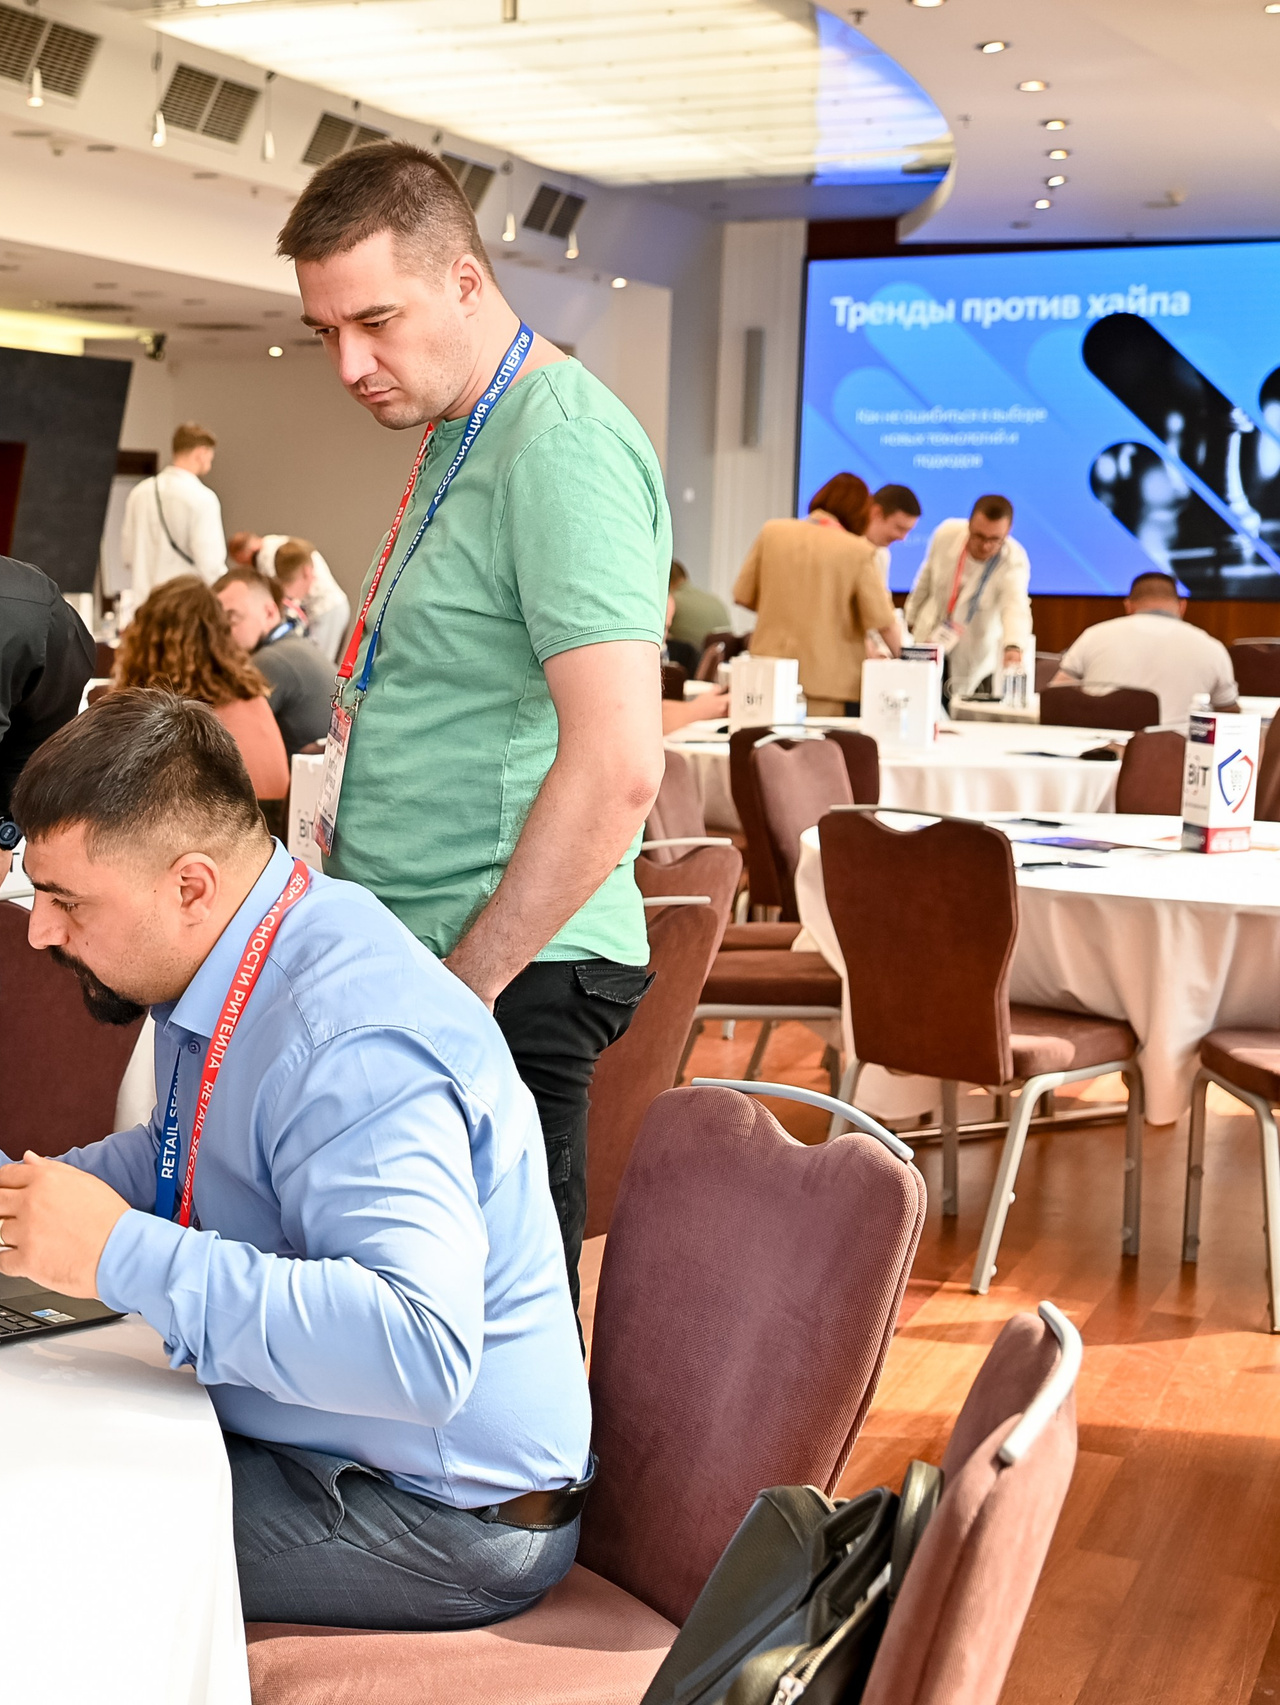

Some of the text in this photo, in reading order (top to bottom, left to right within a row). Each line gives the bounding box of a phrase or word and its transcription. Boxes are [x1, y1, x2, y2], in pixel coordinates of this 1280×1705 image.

[830, 295, 956, 333] Тренды
[961, 293, 1081, 329] против
[433, 332, 531, 505] АССОЦИАЦИЯ ЭКСПЕРТОВ
[161, 1122, 179, 1179] RETAIL
[182, 1080, 214, 1212] RETAIL SECURITY
